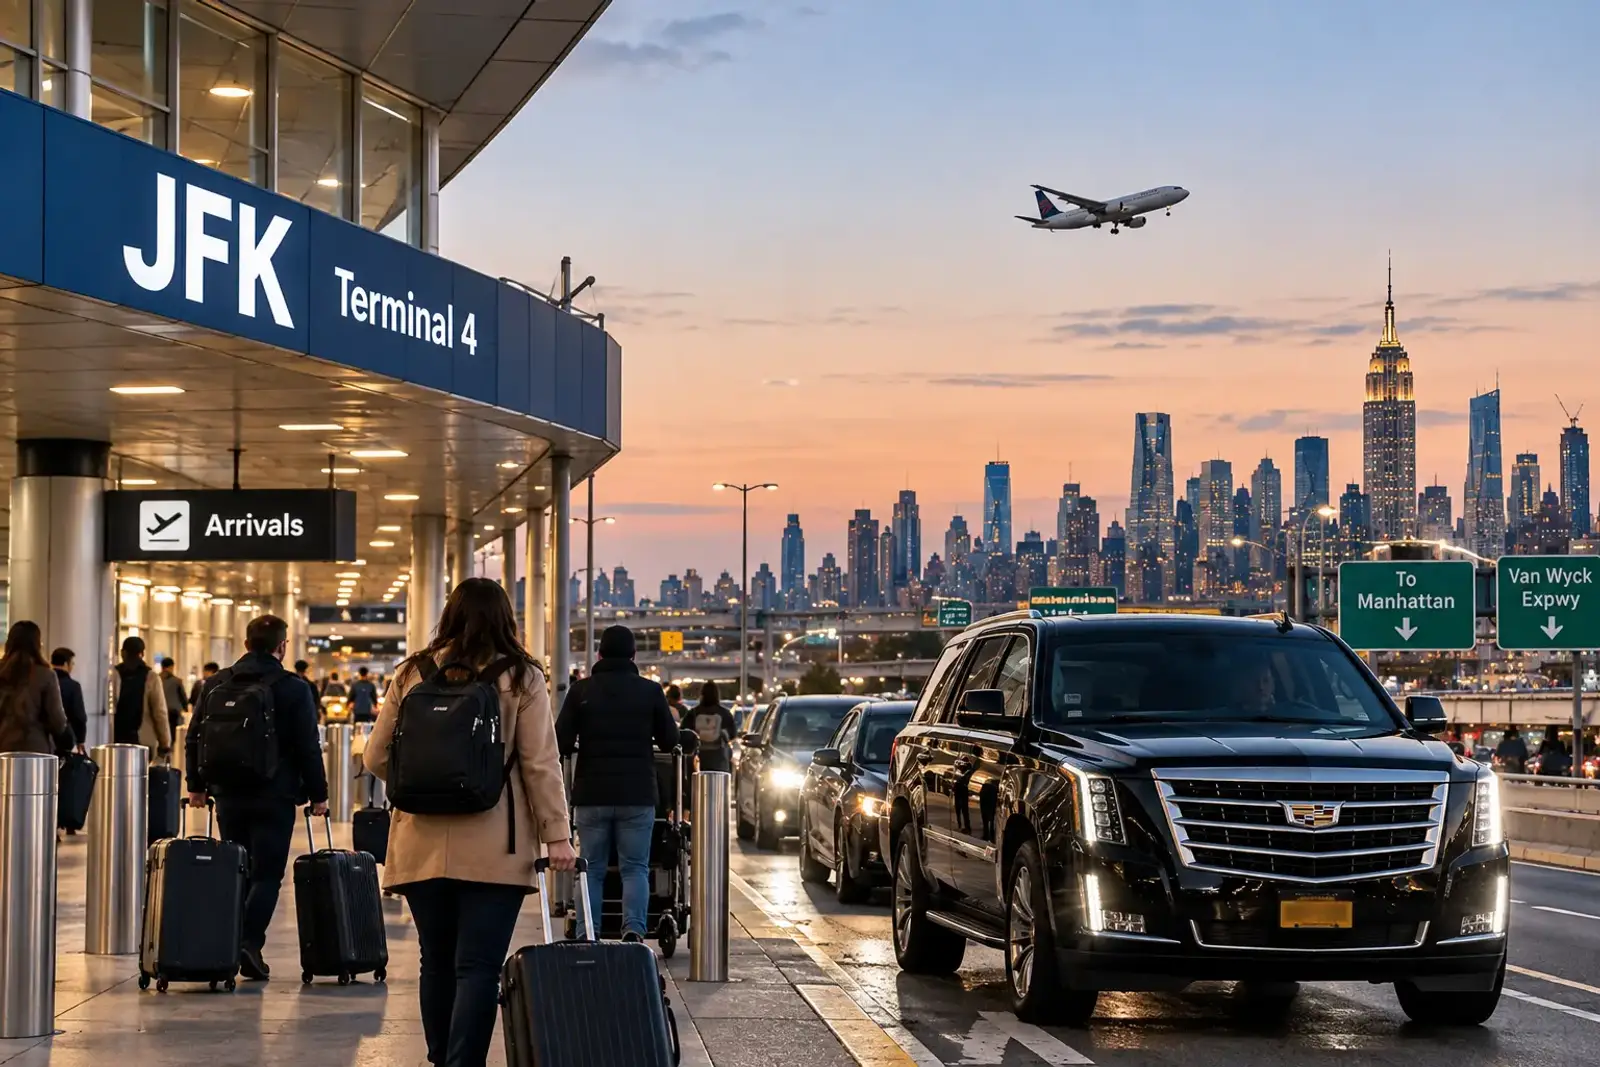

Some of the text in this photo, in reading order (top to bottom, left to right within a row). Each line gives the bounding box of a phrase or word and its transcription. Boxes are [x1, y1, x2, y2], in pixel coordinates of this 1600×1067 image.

[122, 172, 295, 329] JFK
[334, 266, 478, 356] Terminal 4
[204, 512, 304, 537] Arrivals
[1396, 571, 1417, 588] To
[1508, 567, 1592, 588] Van Wyck
[1358, 593, 1455, 609] Manhattan
[1522, 591, 1580, 611] Expwy
